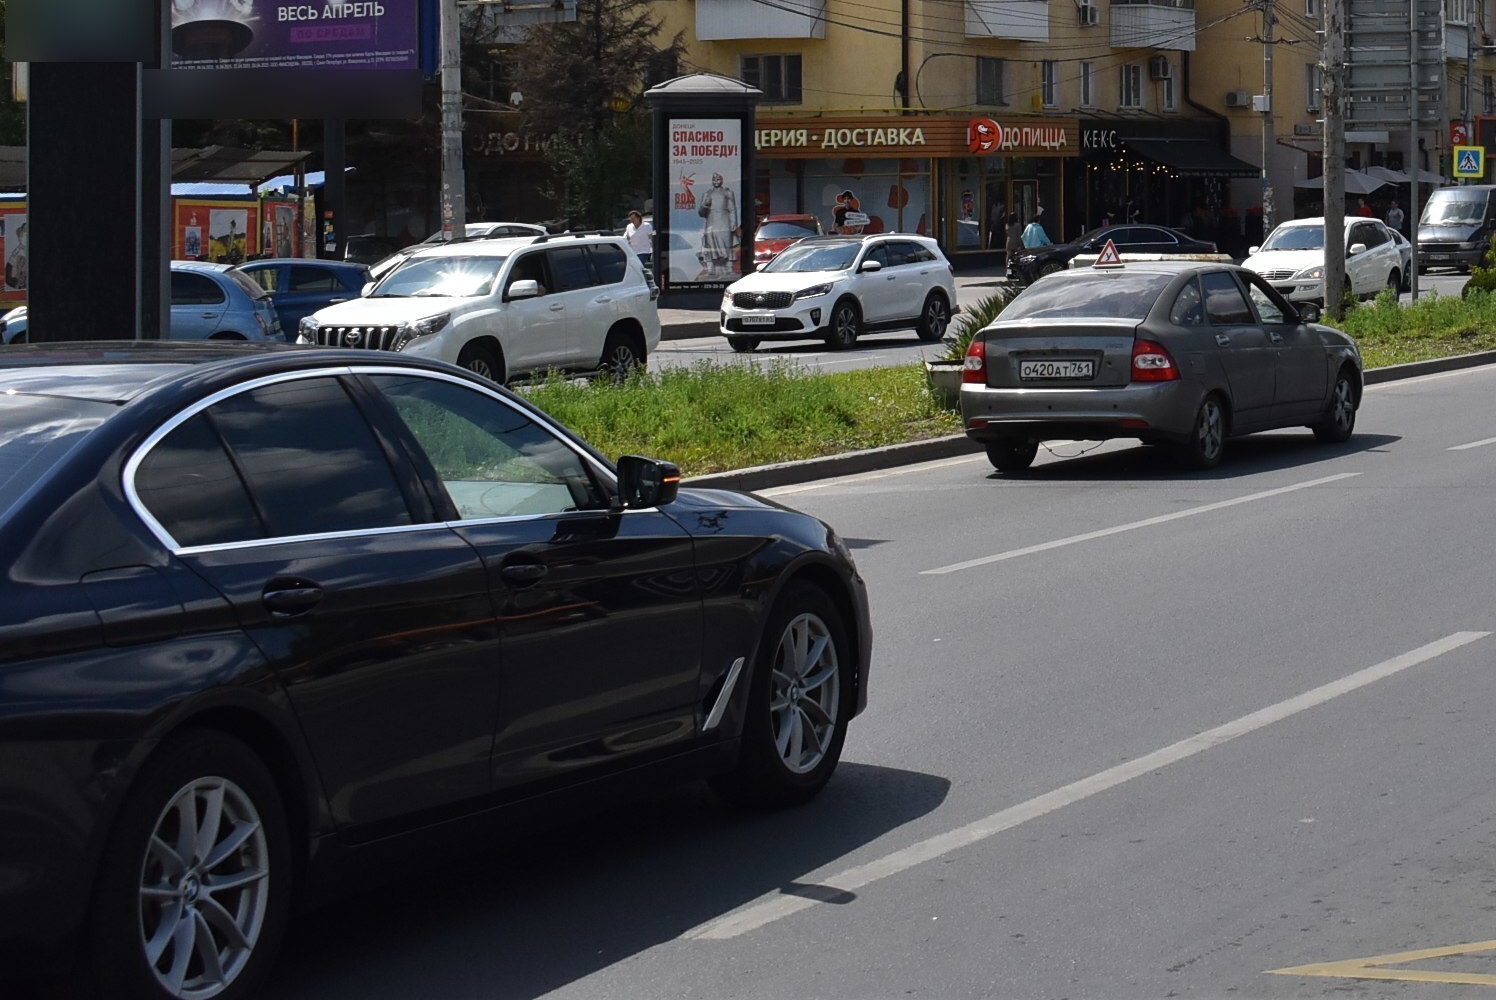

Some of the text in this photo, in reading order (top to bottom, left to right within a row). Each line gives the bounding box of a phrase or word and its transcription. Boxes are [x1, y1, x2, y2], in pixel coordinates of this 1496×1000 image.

[278, 1, 385, 21] ВЕСЬ АПРЕЛЬ
[672, 130, 724, 142] СПАСИБО
[821, 127, 926, 149] ДОСТАВКА
[1022, 127, 1067, 150] ПИЦЦА
[672, 145, 738, 158] ЗА ПОБЕДУ!
